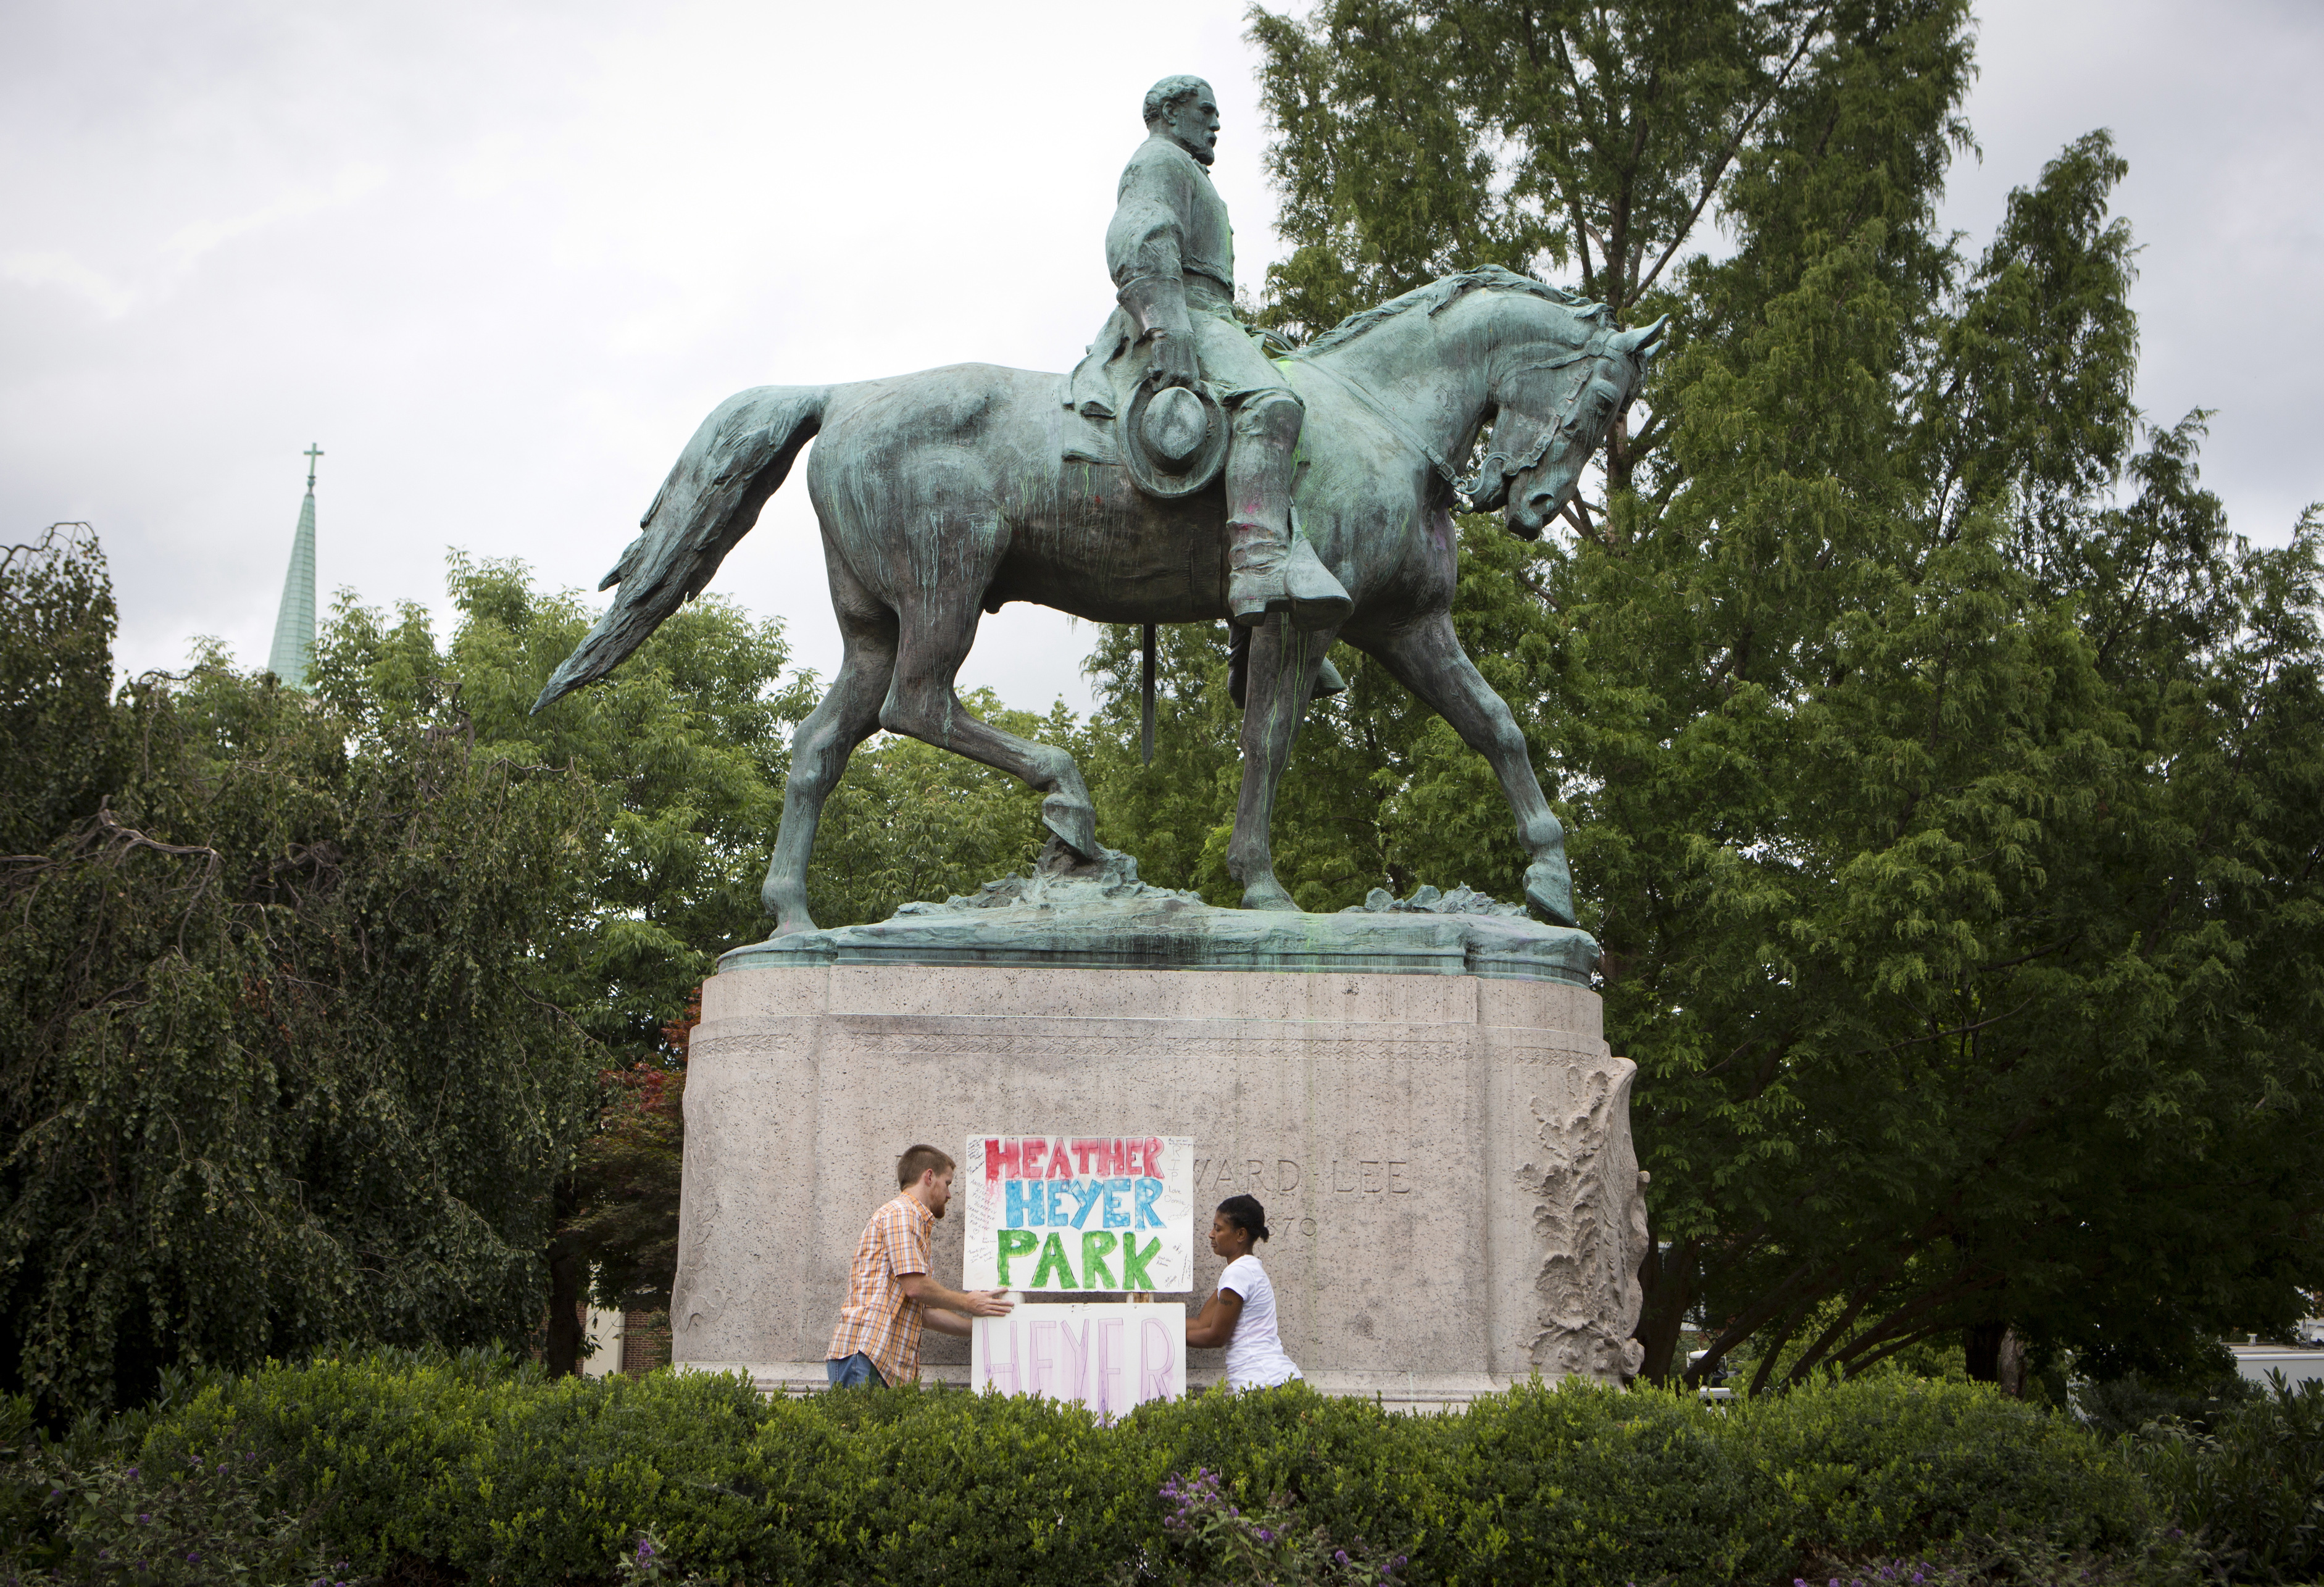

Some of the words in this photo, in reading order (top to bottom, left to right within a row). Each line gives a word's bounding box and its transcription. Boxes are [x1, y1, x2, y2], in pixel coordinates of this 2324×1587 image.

[985, 1136, 1164, 1178] HEATHER
[1333, 1160, 1410, 1194] LEE
[1006, 1178, 1167, 1232] HEYER
[997, 1230, 1163, 1291] PARK
